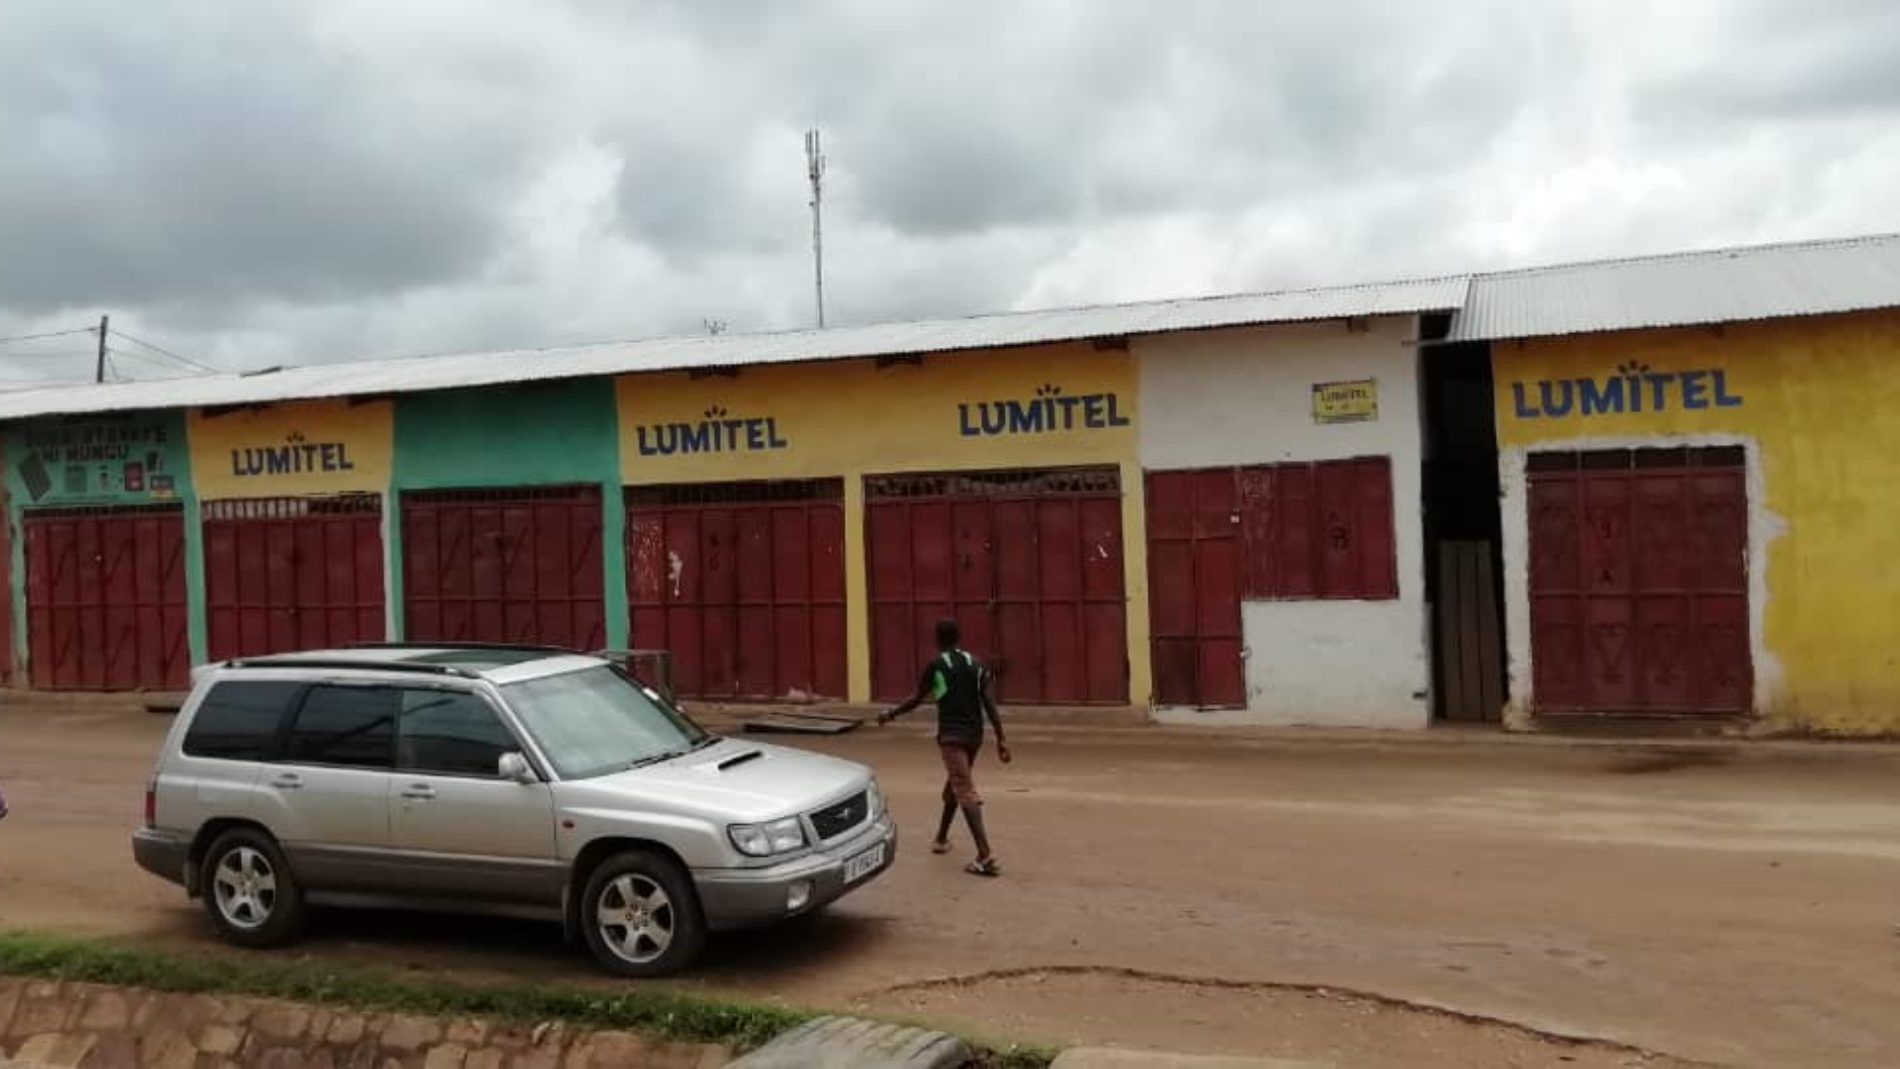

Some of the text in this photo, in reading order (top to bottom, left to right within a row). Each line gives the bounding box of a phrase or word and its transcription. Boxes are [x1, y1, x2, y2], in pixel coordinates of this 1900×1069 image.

[958, 392, 1130, 436] LUMITEL
[1512, 368, 1743, 418] LUMITEL
[636, 415, 787, 456] LUMITEL
[231, 442, 354, 475] LUMITEL
